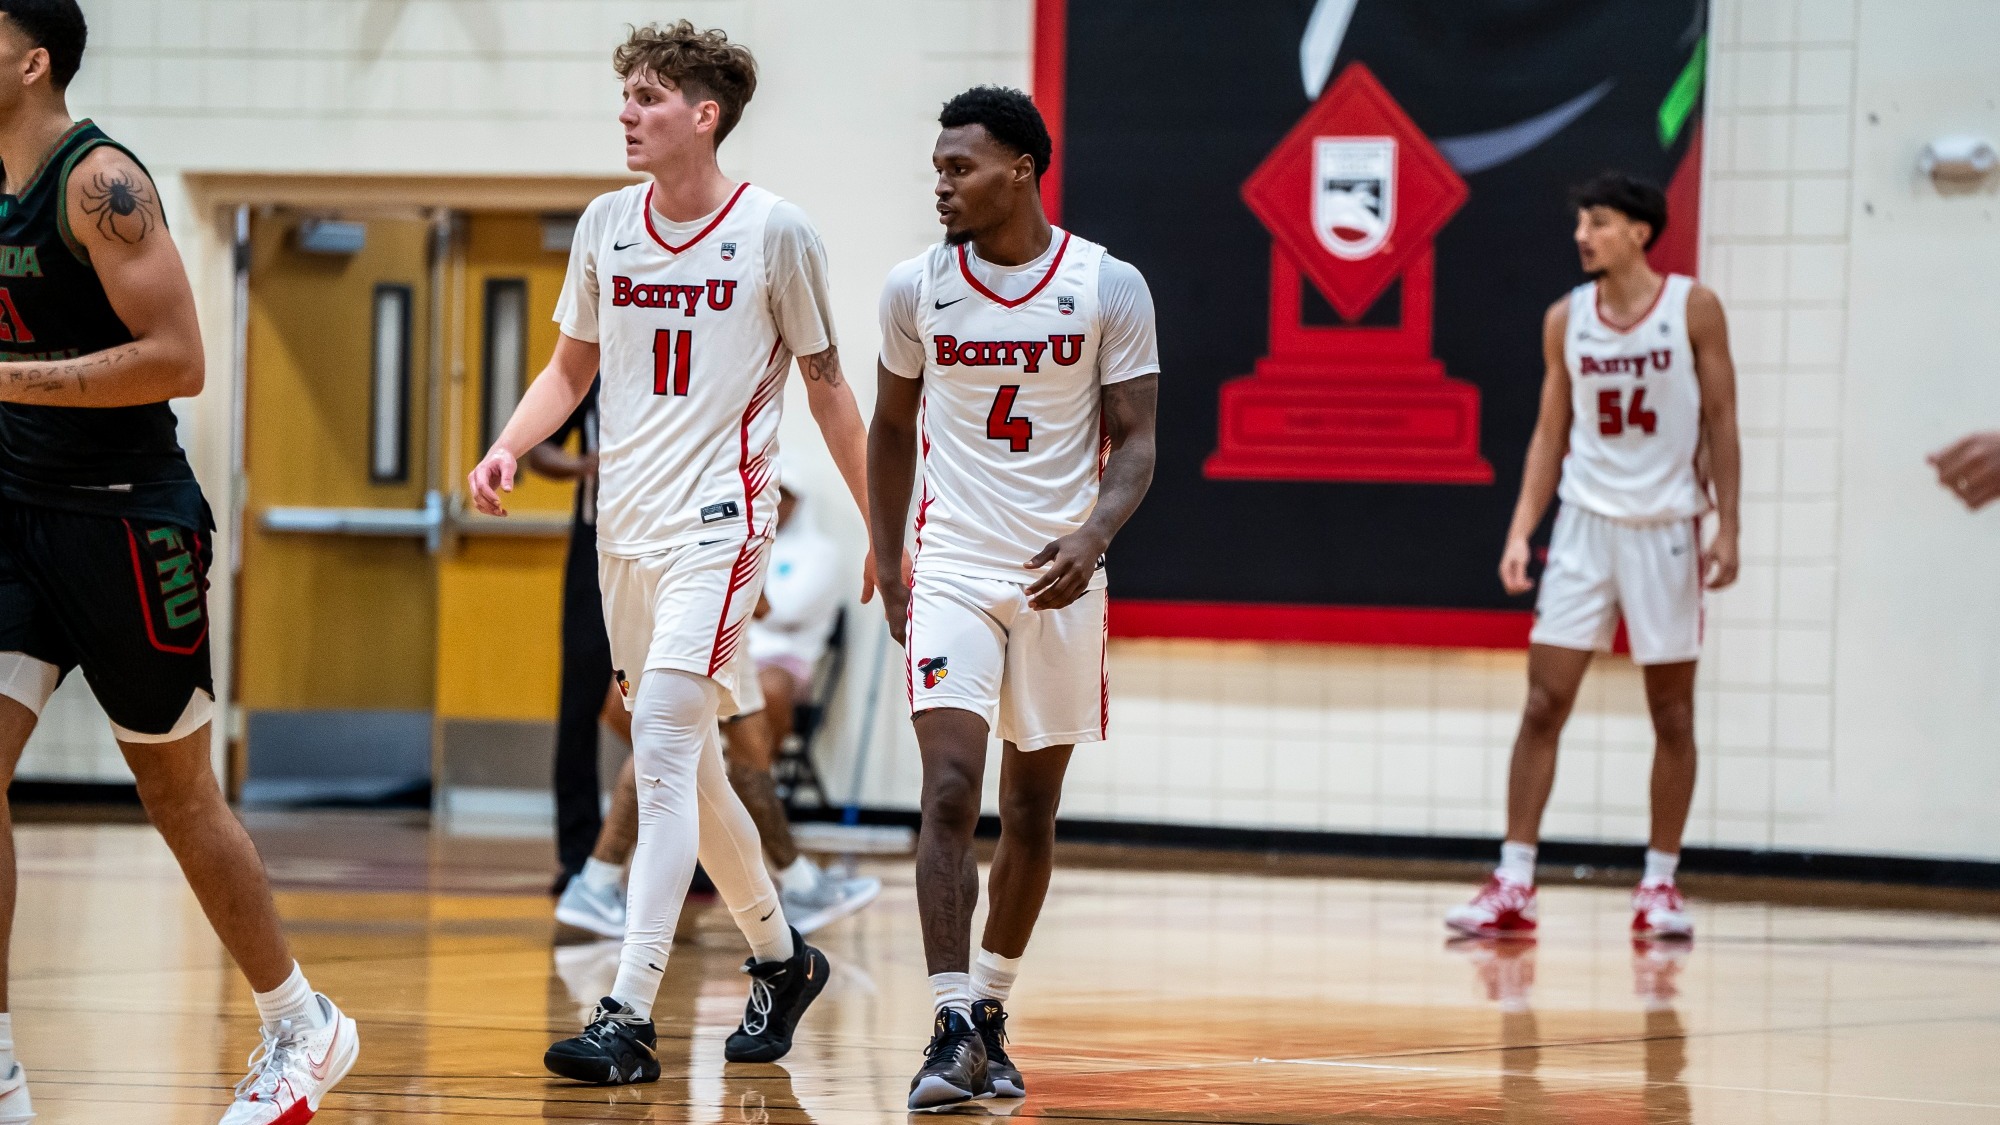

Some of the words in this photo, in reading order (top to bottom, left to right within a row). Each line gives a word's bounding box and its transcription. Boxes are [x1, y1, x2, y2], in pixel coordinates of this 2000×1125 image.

[612, 275, 704, 317] Barry
[706, 279, 737, 311] U
[652, 329, 692, 396] 11
[934, 335, 1047, 373] Barry
[1048, 334, 1085, 366] U
[986, 385, 1033, 452] 4
[1597, 386, 1658, 437] 54
